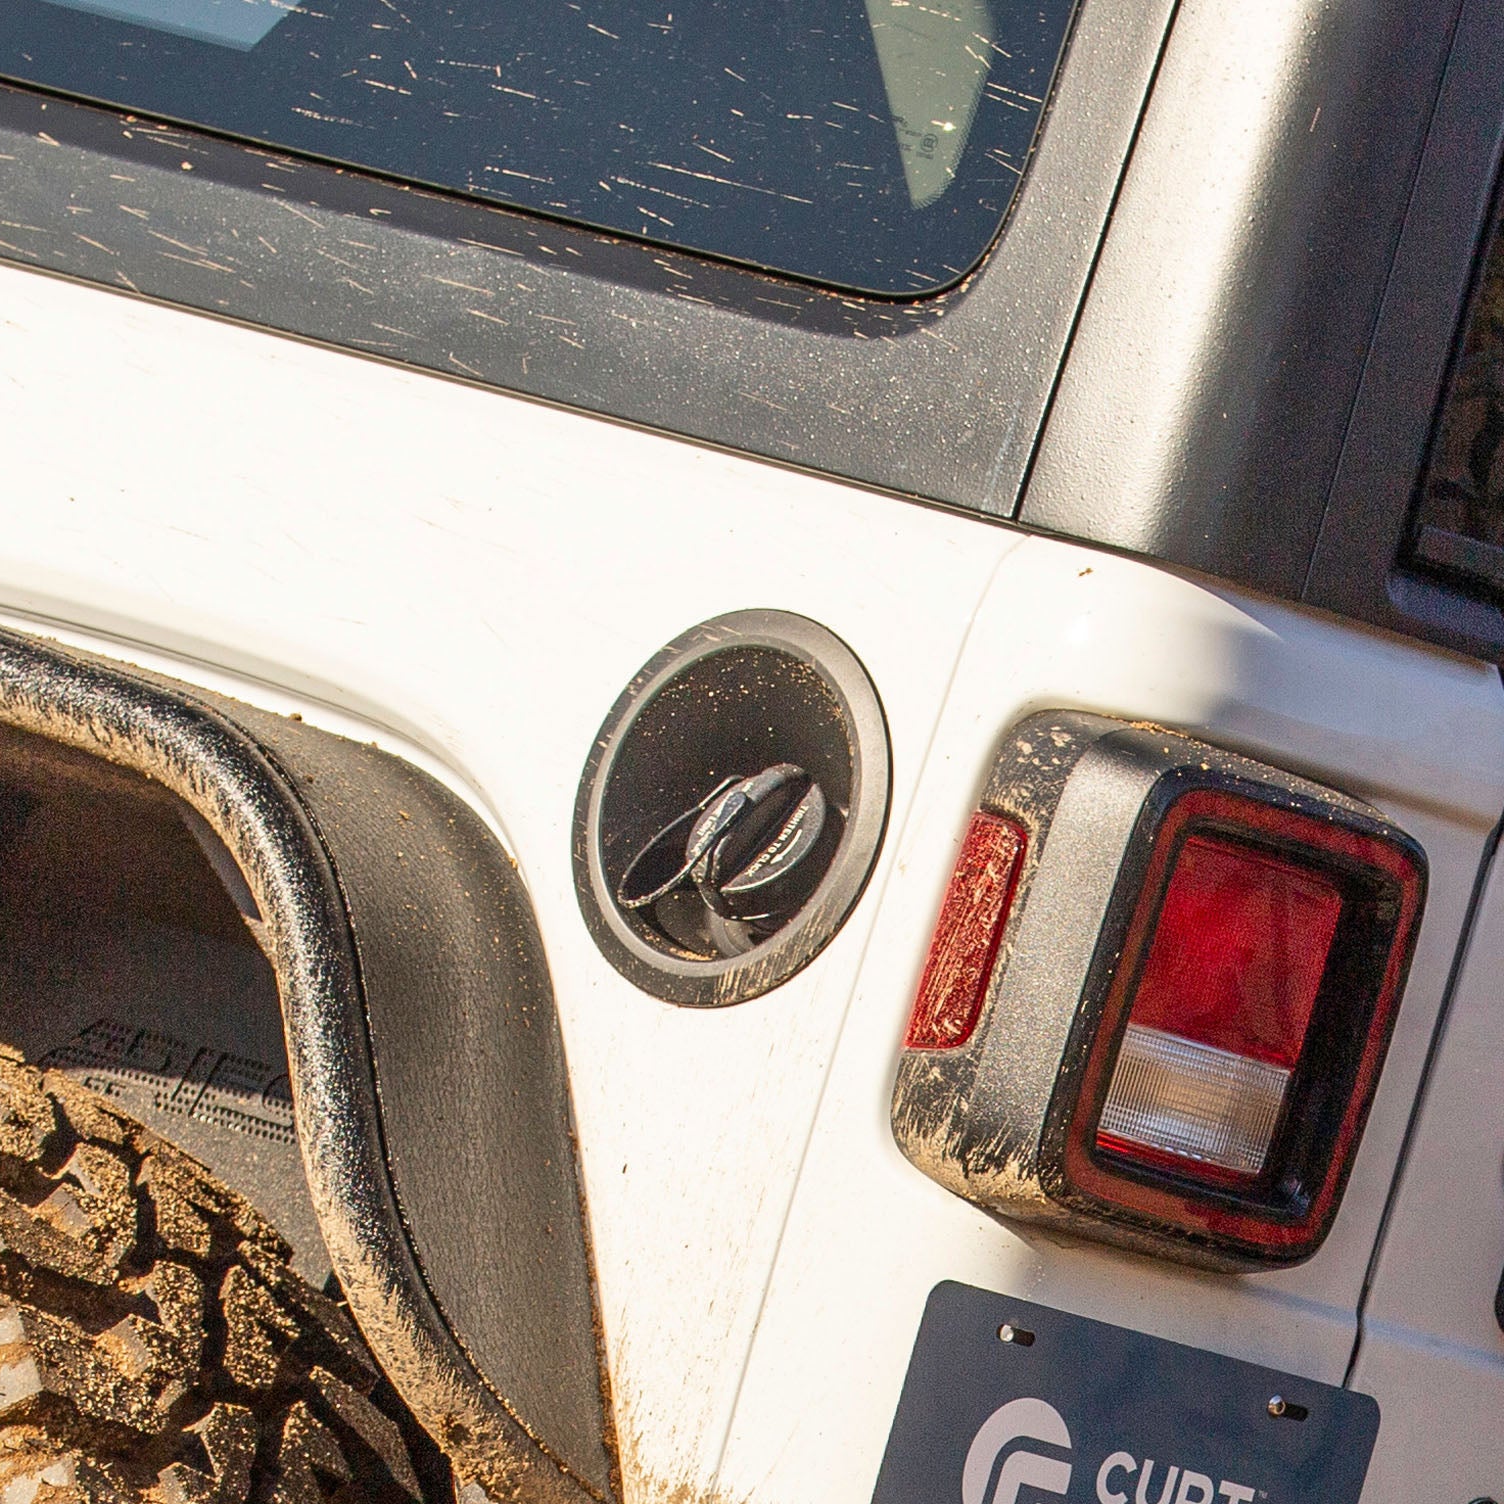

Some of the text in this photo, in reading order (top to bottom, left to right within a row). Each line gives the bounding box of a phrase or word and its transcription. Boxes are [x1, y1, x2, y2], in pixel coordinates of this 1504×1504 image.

[744, 805, 809, 877] TIGHTEN TO CLICK
